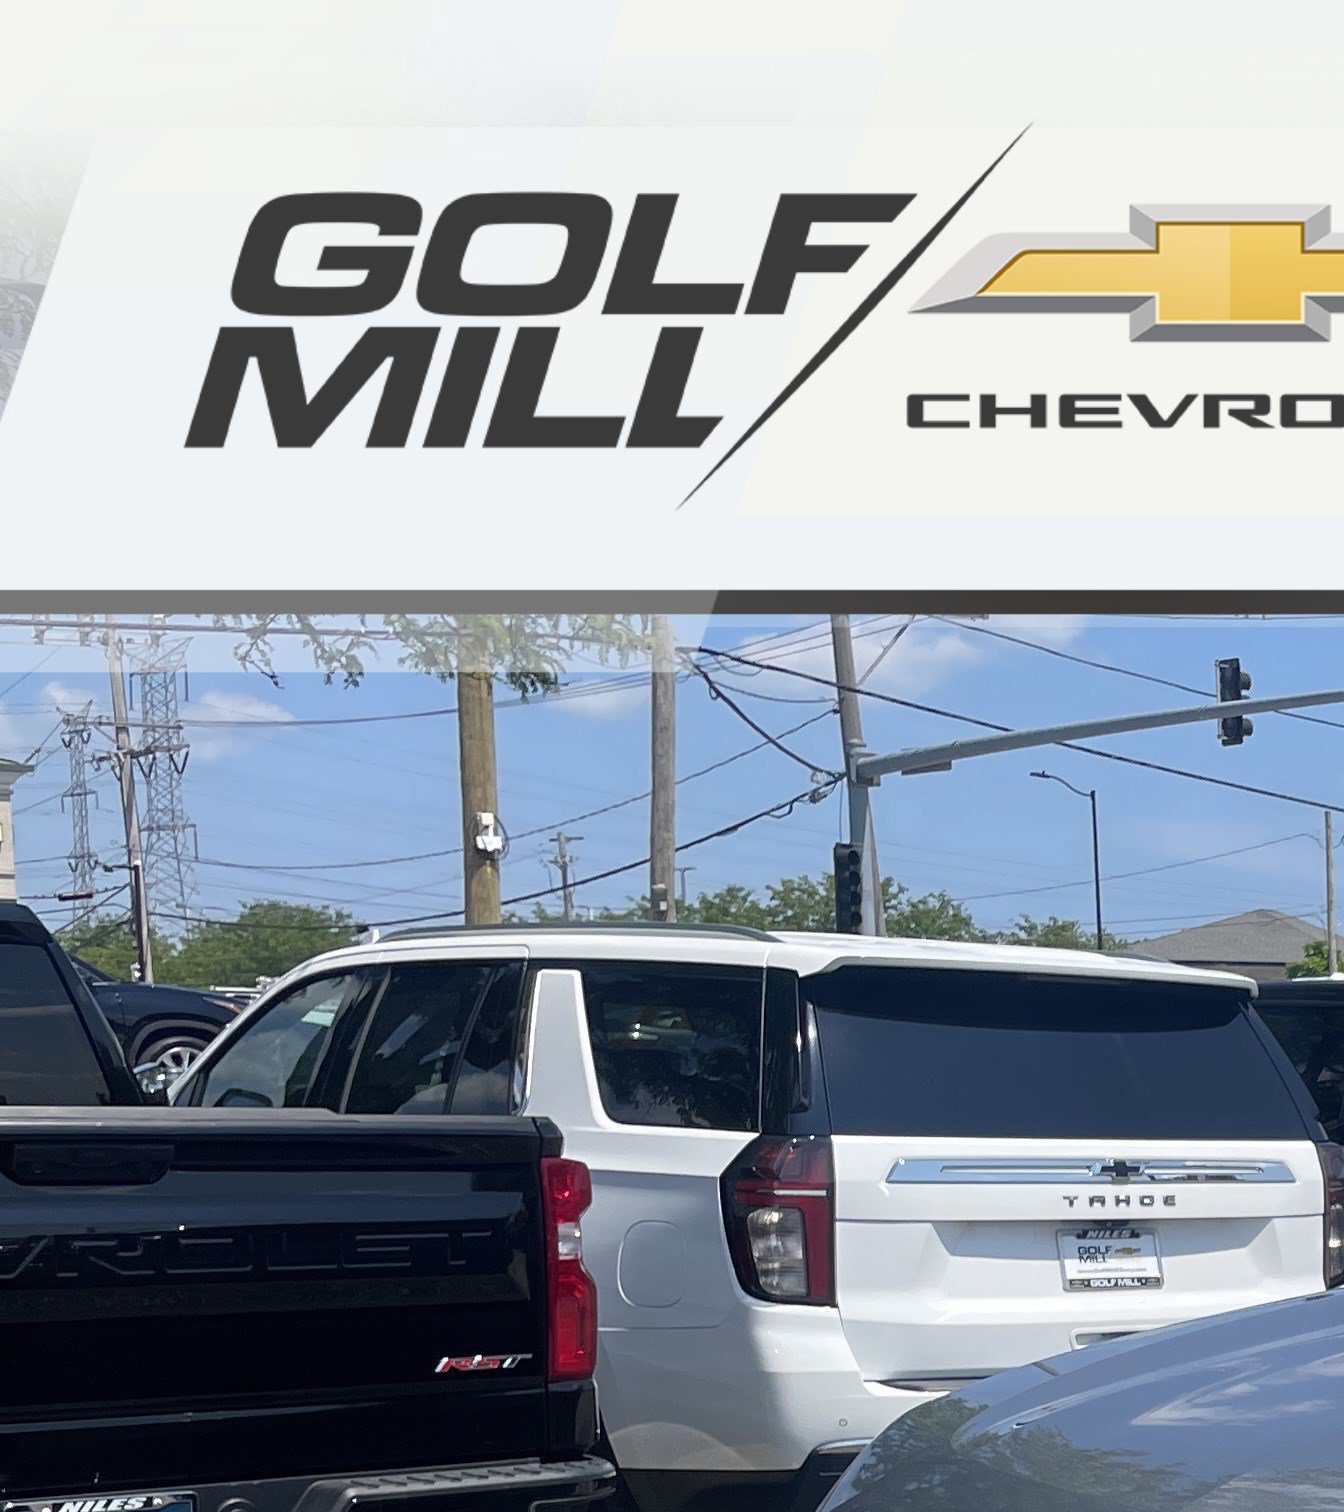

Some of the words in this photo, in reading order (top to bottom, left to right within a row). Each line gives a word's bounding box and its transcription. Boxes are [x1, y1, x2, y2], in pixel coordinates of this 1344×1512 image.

[1062, 1194, 1177, 1208] TAHOE
[1077, 1245, 1113, 1256] GOLF
[1089, 1278, 1117, 1288] GOLF
[435, 1353, 533, 1373] RST
